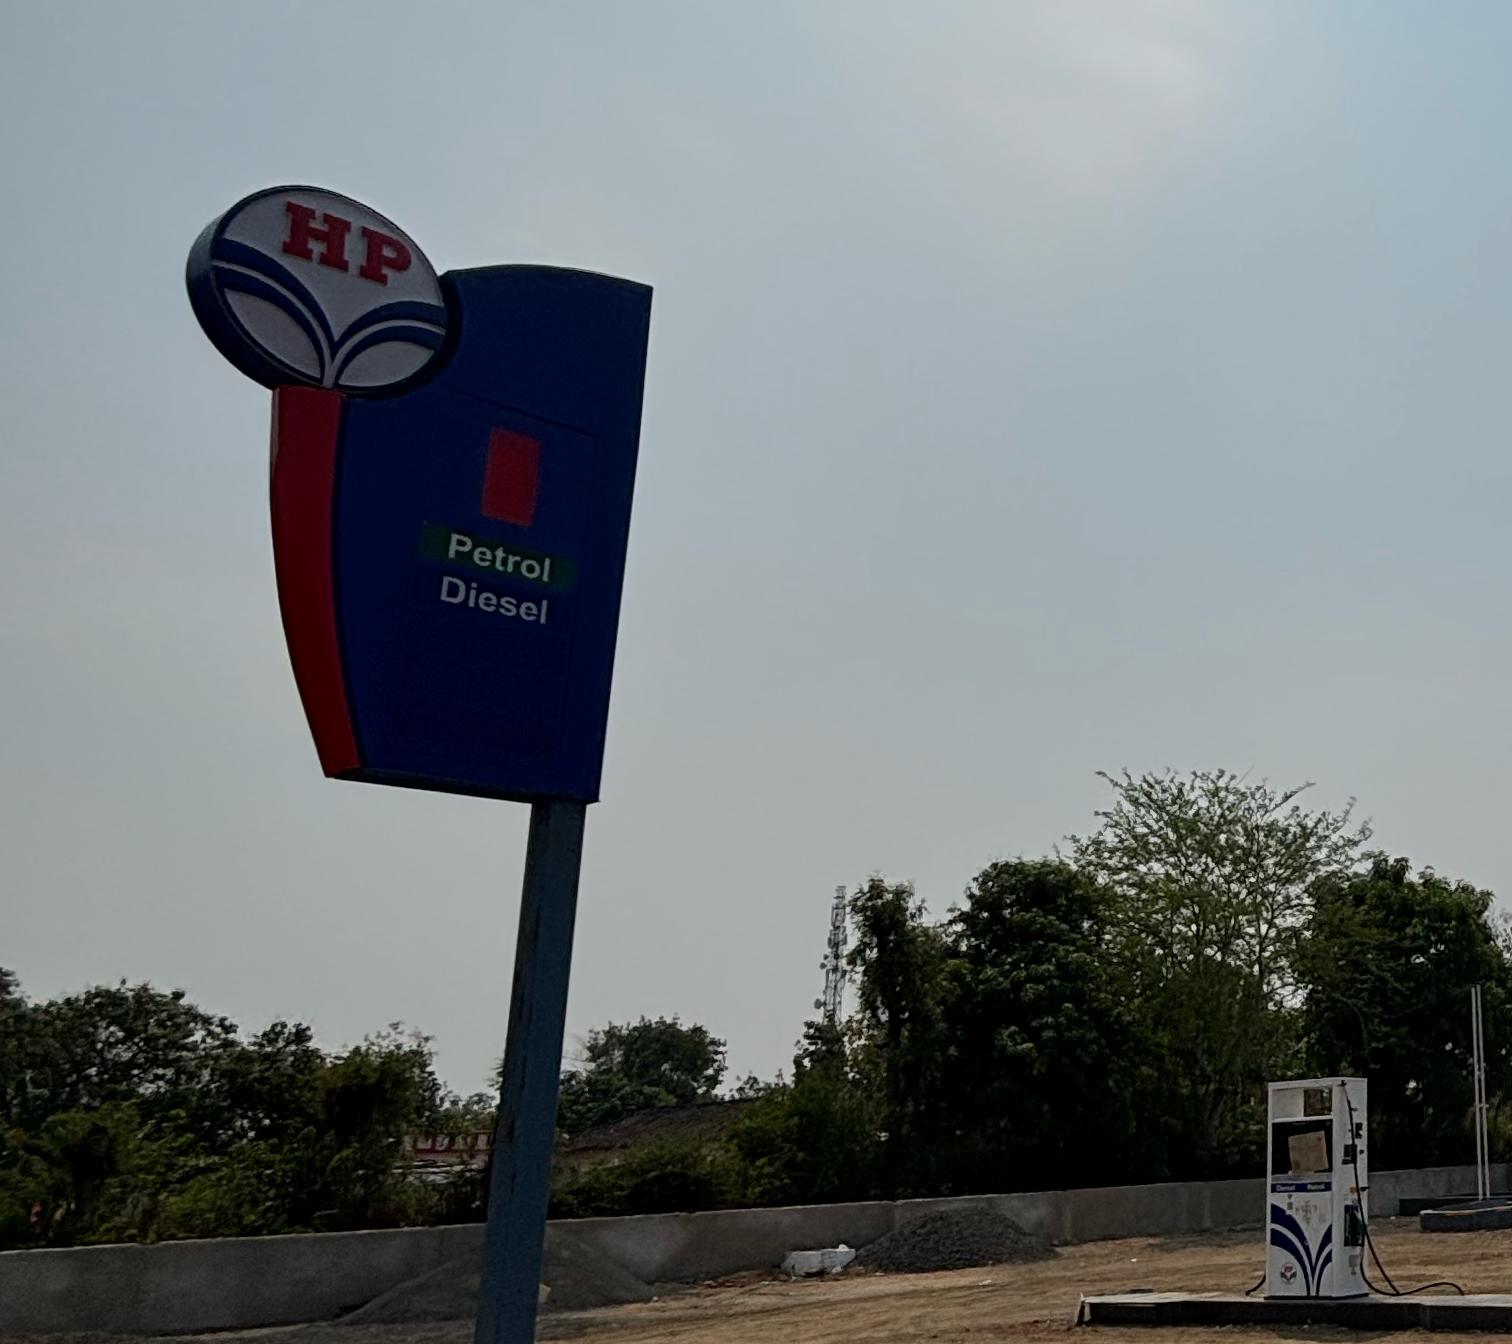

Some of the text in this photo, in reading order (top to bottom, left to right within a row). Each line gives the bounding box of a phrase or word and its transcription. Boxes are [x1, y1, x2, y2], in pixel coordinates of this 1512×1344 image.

[282, 201, 412, 286] HP
[448, 533, 551, 582] Petrol
[440, 576, 548, 624] Diesel
